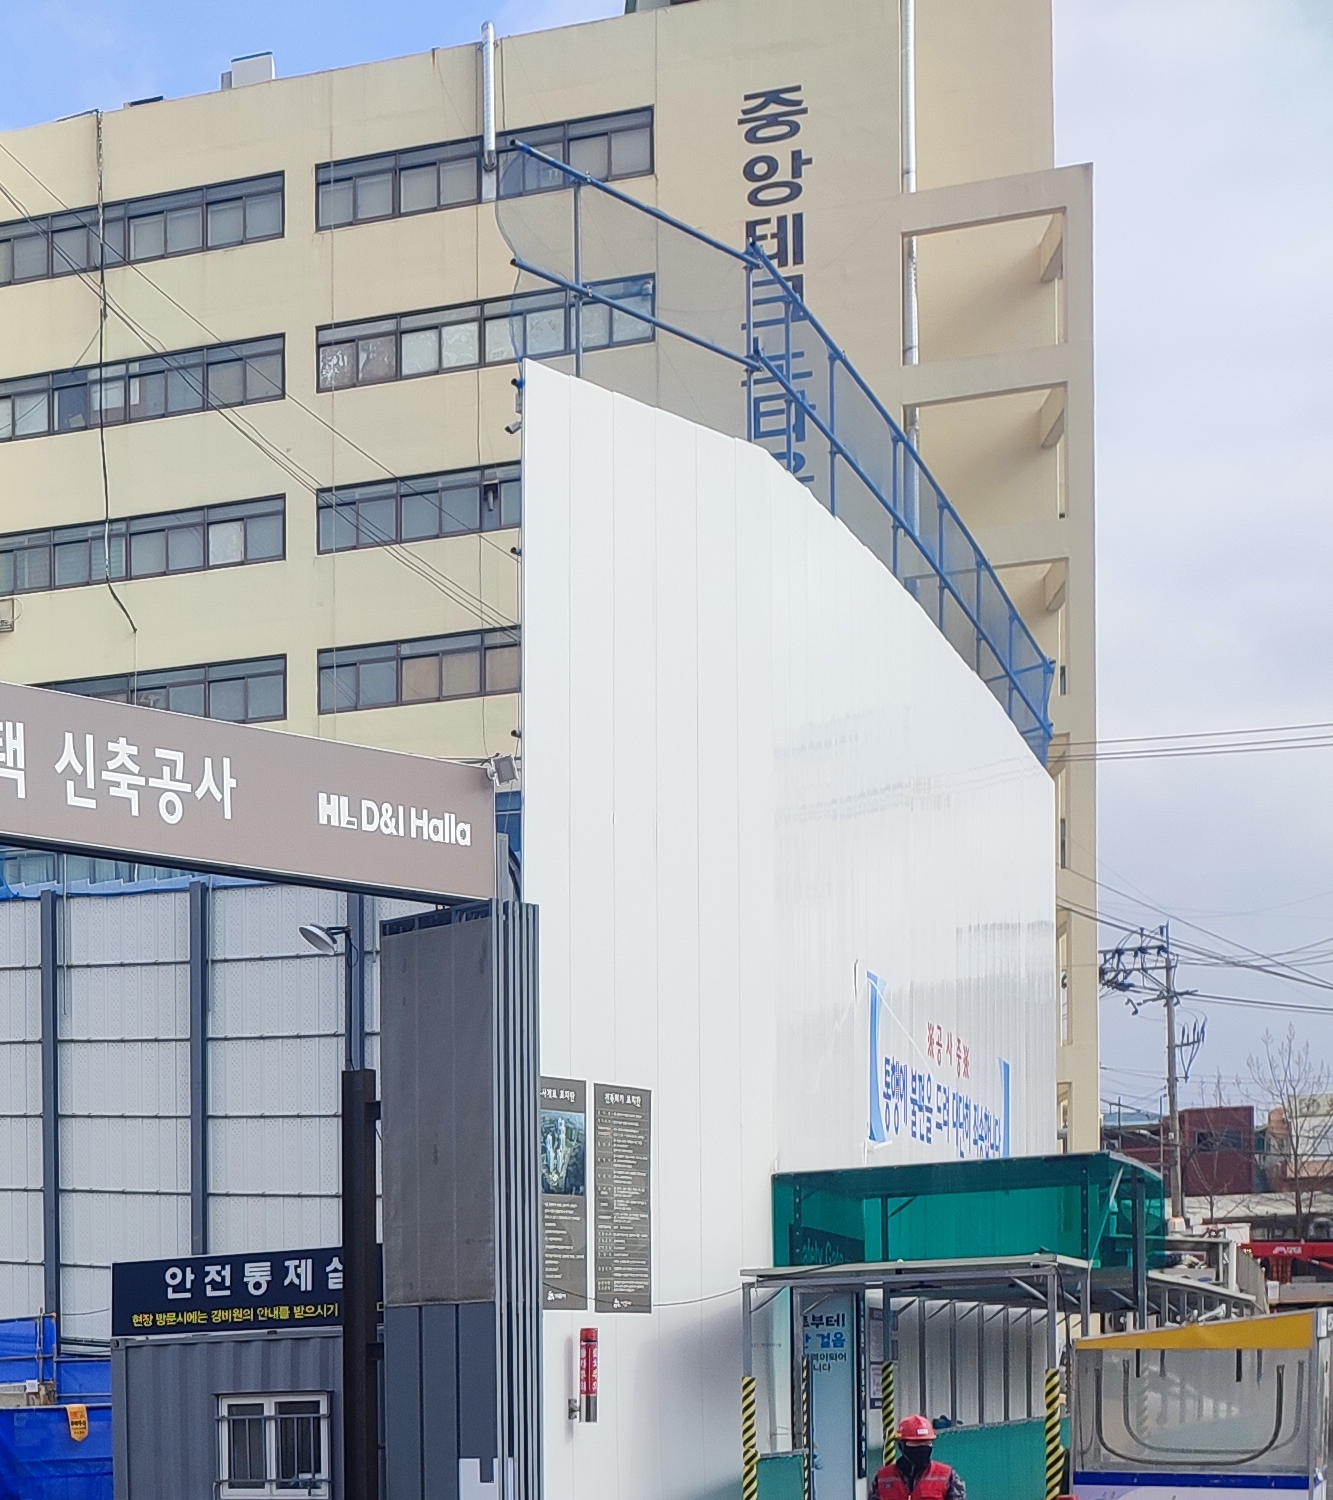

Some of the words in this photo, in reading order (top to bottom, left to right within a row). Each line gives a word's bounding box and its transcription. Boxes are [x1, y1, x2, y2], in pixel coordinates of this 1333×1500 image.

[53, 731, 237, 825] 신축공사
[318, 791, 359, 830] HL
[360, 798, 405, 837] D&I
[410, 808, 472, 847] Halla
[132, 1314, 153, 1327] 현장
[210, 1307, 254, 1323] 경비원의
[256, 1305, 290, 1321] 안내를
[293, 1303, 338, 1318] 받으시기
[816, 1332, 846, 1349] 걸음
